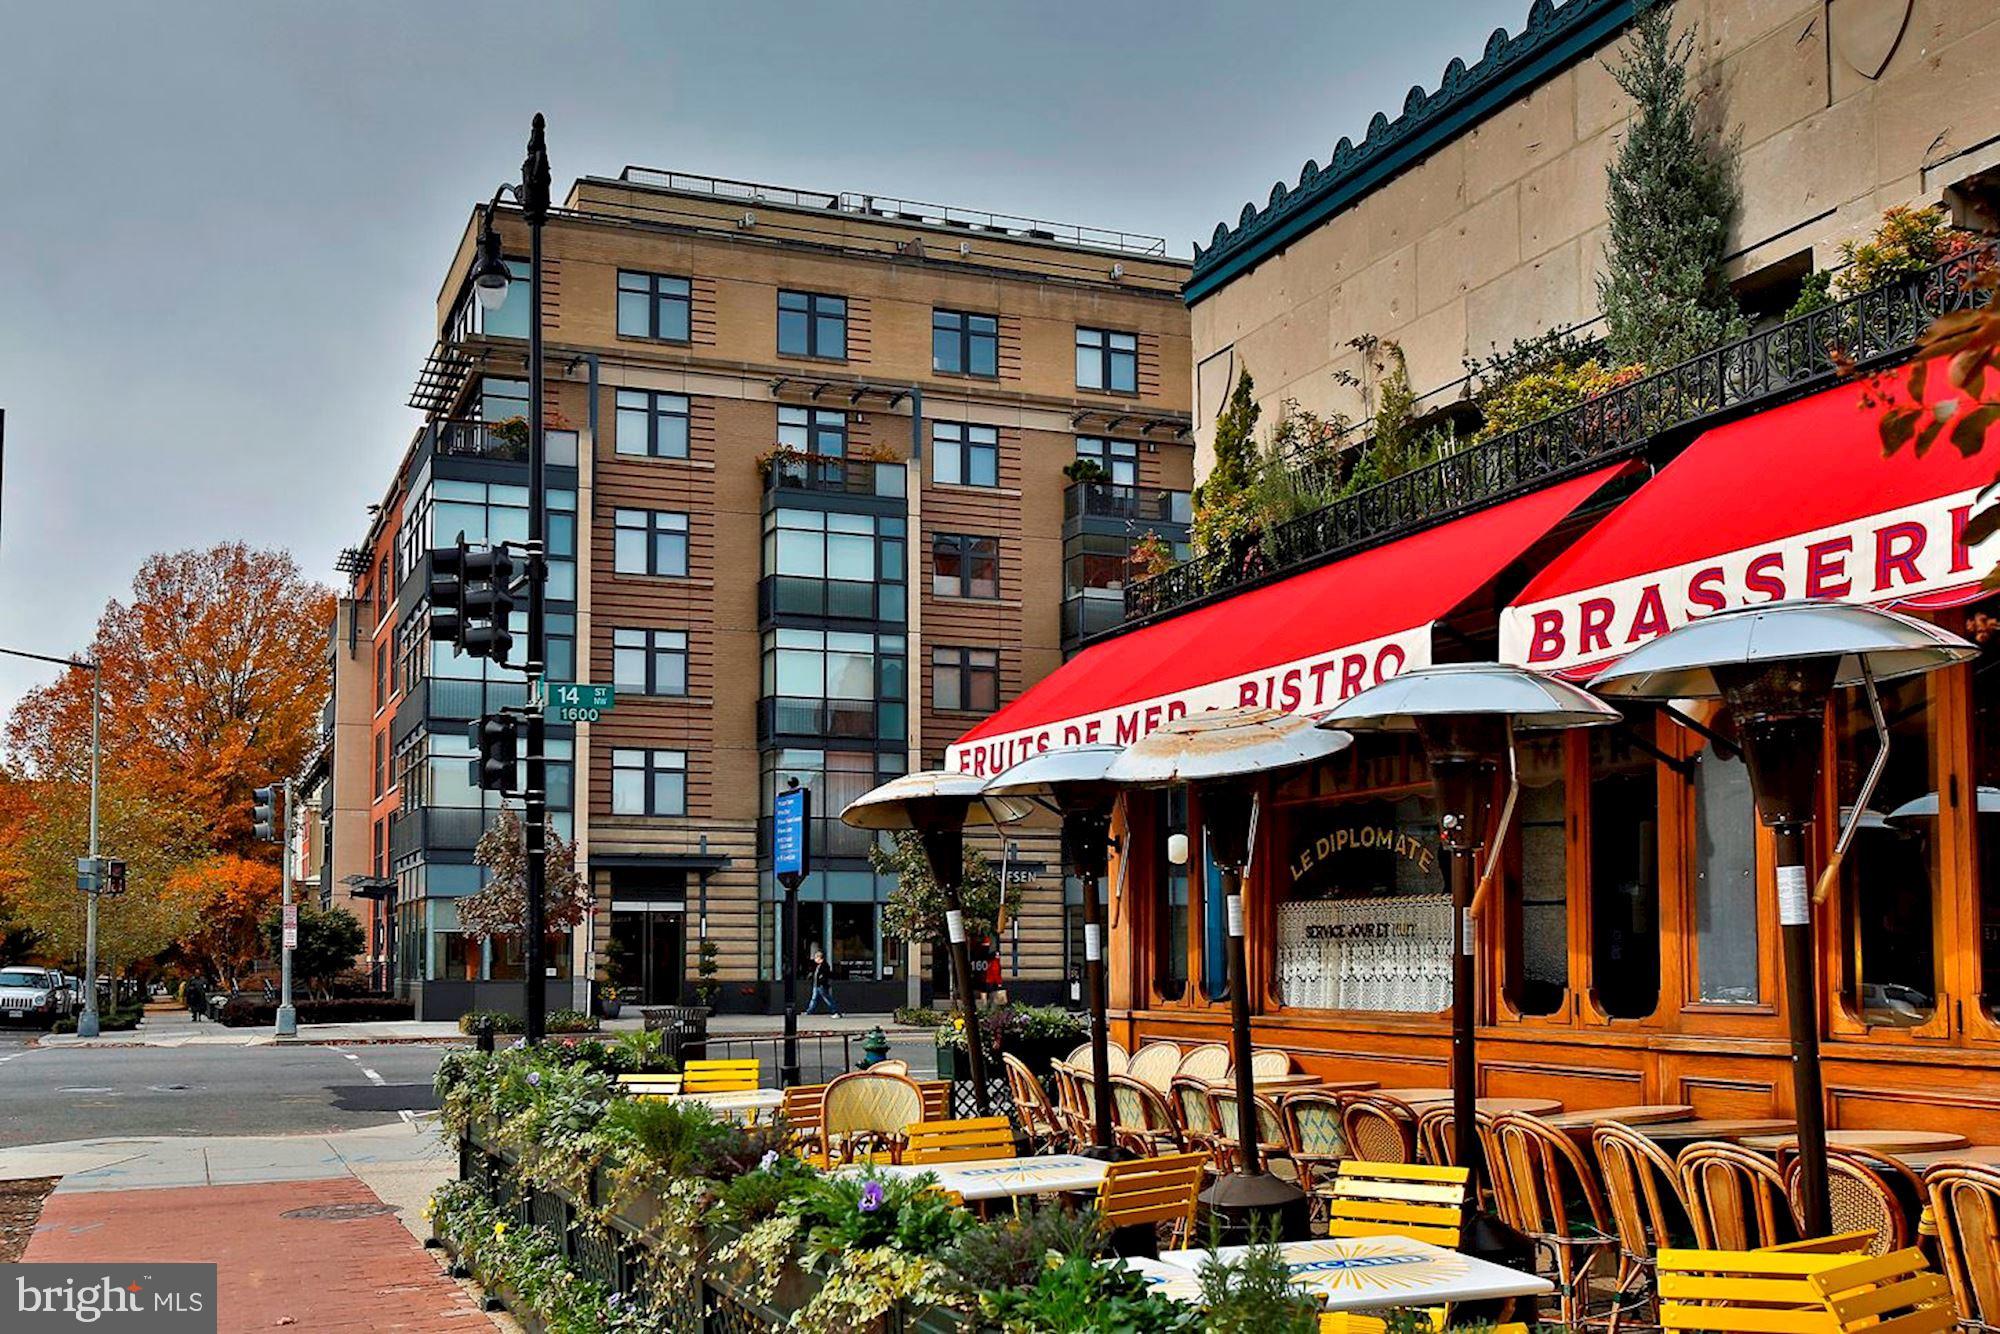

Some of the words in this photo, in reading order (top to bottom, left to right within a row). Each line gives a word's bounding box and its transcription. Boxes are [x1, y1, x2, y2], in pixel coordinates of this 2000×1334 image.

[1526, 496, 2000, 664] BRASSERI
[558, 686, 580, 704] 14
[594, 688, 607, 697] ST
[959, 731, 1050, 776] FRUITS
[1238, 643, 1406, 713] BISTRO
[561, 708, 599, 721] 1600
[1290, 848, 1314, 881] LE
[1315, 825, 1434, 874] DIPLOMATE
[970, 960, 992, 971] 160
